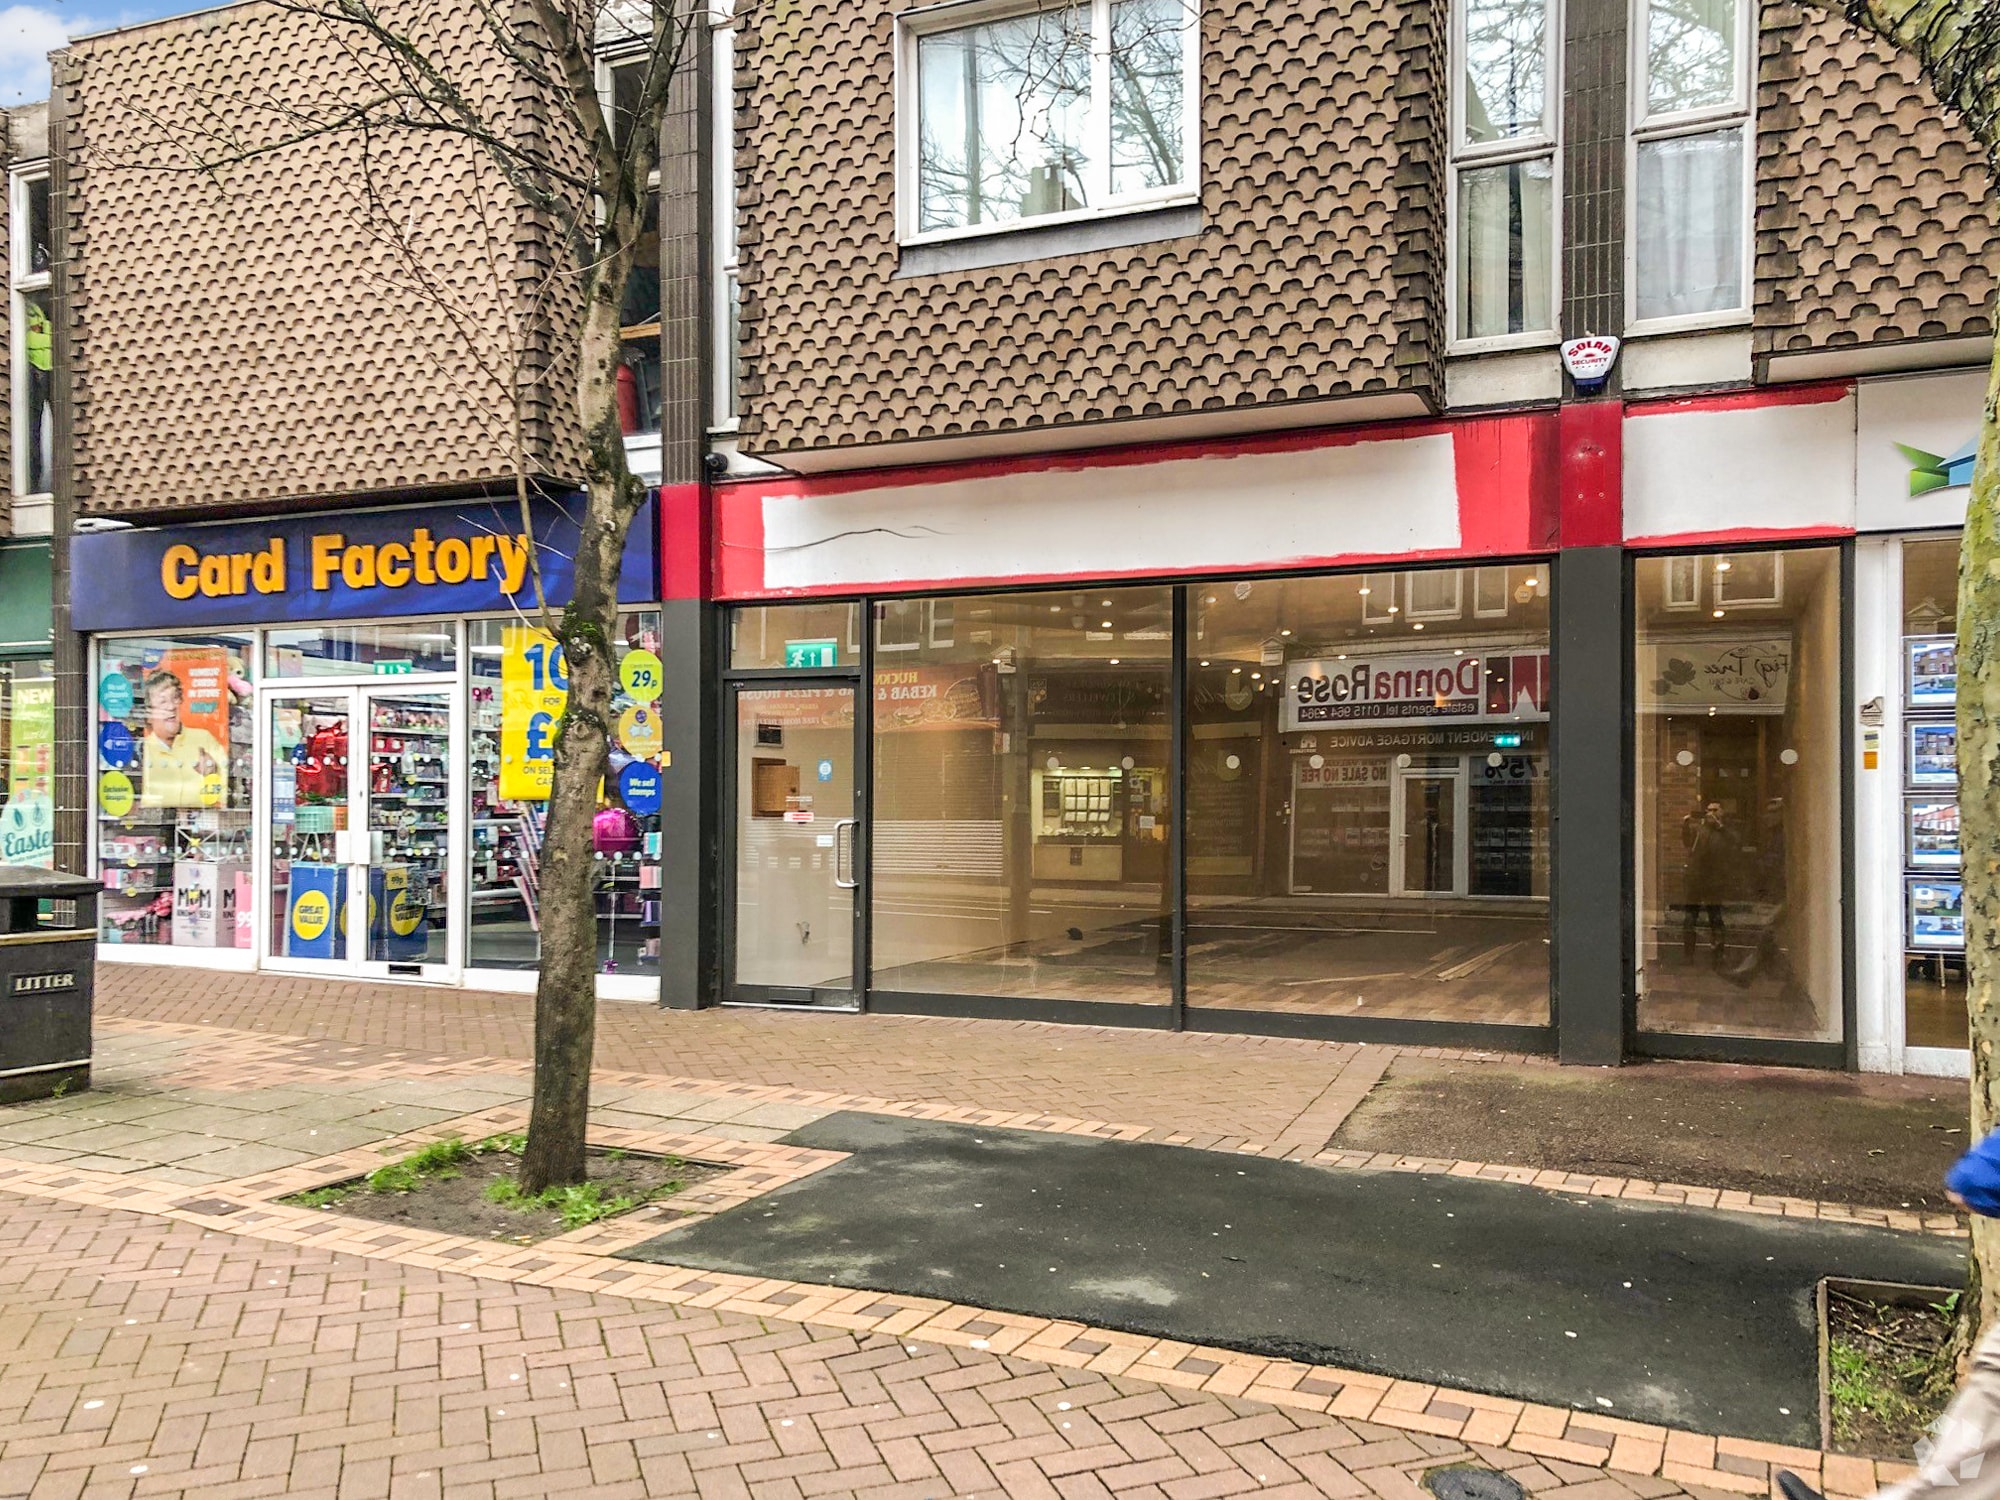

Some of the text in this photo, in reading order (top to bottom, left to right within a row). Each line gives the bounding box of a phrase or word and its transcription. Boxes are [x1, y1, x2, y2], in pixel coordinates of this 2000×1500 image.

[1567, 340, 1612, 357] SOLAR
[1571, 357, 1608, 366] SECURITY
[161, 528, 528, 599] Card Factory
[18, 688, 54, 704] NEW
[543, 697, 561, 706] FOR
[523, 766, 536, 774] ON
[299, 905, 325, 914] GREAT
[300, 914, 324, 925] VALUE
[15, 973, 74, 991] LITTER
